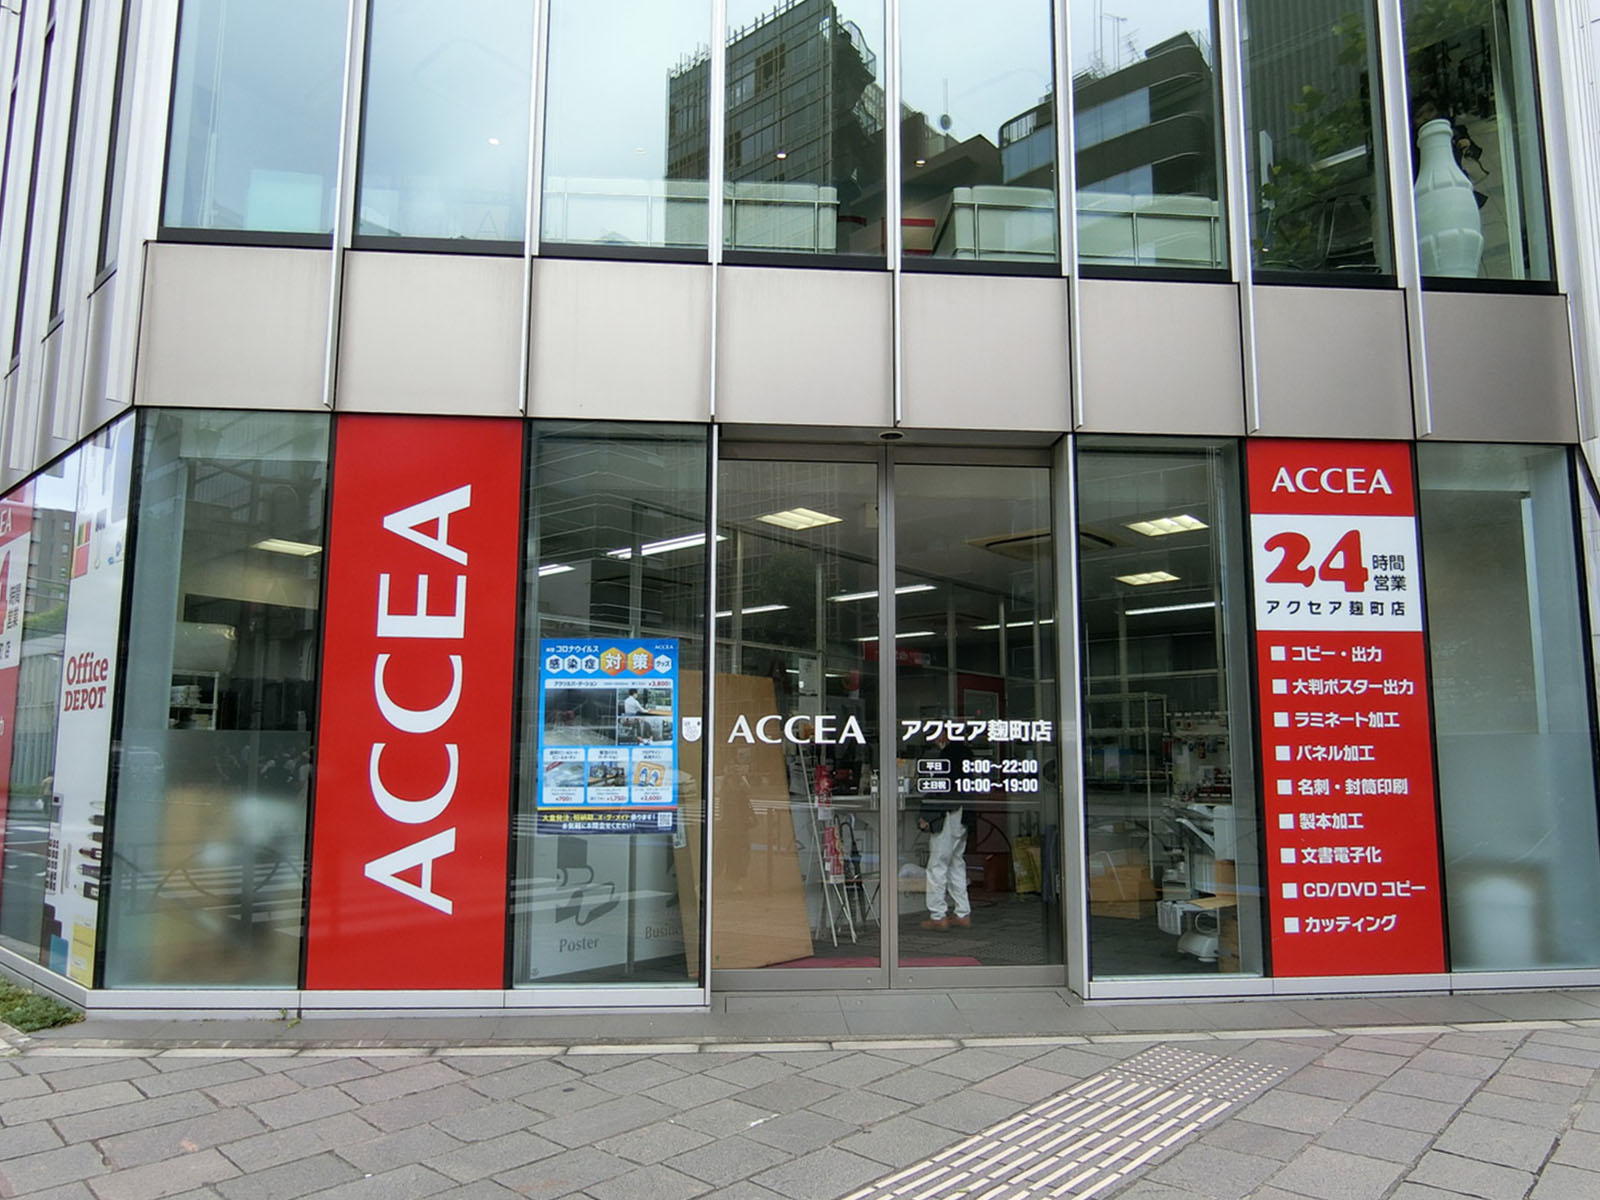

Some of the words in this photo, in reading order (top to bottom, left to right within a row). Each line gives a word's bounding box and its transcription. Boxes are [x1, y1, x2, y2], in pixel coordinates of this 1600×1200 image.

[1271, 466, 1393, 495] ACCEA
[1263, 528, 1369, 593] 24
[1372, 554, 1406, 572] 時間
[1373, 575, 1407, 591] 営業
[1291, 645, 1383, 663] コピー・出力
[66, 652, 109, 685] Office
[1292, 678, 1414, 696] 大判ポスター出力
[64, 686, 107, 712] DEPOT
[363, 483, 472, 915] ACCEA
[1294, 711, 1400, 728] ラミネート加工
[727, 714, 866, 745] ACCEA
[1296, 745, 1375, 762] パネル加工
[926, 762, 942, 771] 平日
[1297, 778, 1408, 796] 名刺・封筒印刷
[1299, 812, 1364, 831] 製本加工
[1301, 846, 1383, 865] 文書電子化
[1302, 882, 1377, 899] CD/DVD
[1381, 879, 1427, 897] コピー
[1304, 913, 1397, 933] カッティング
[559, 937, 600, 953] Poster
